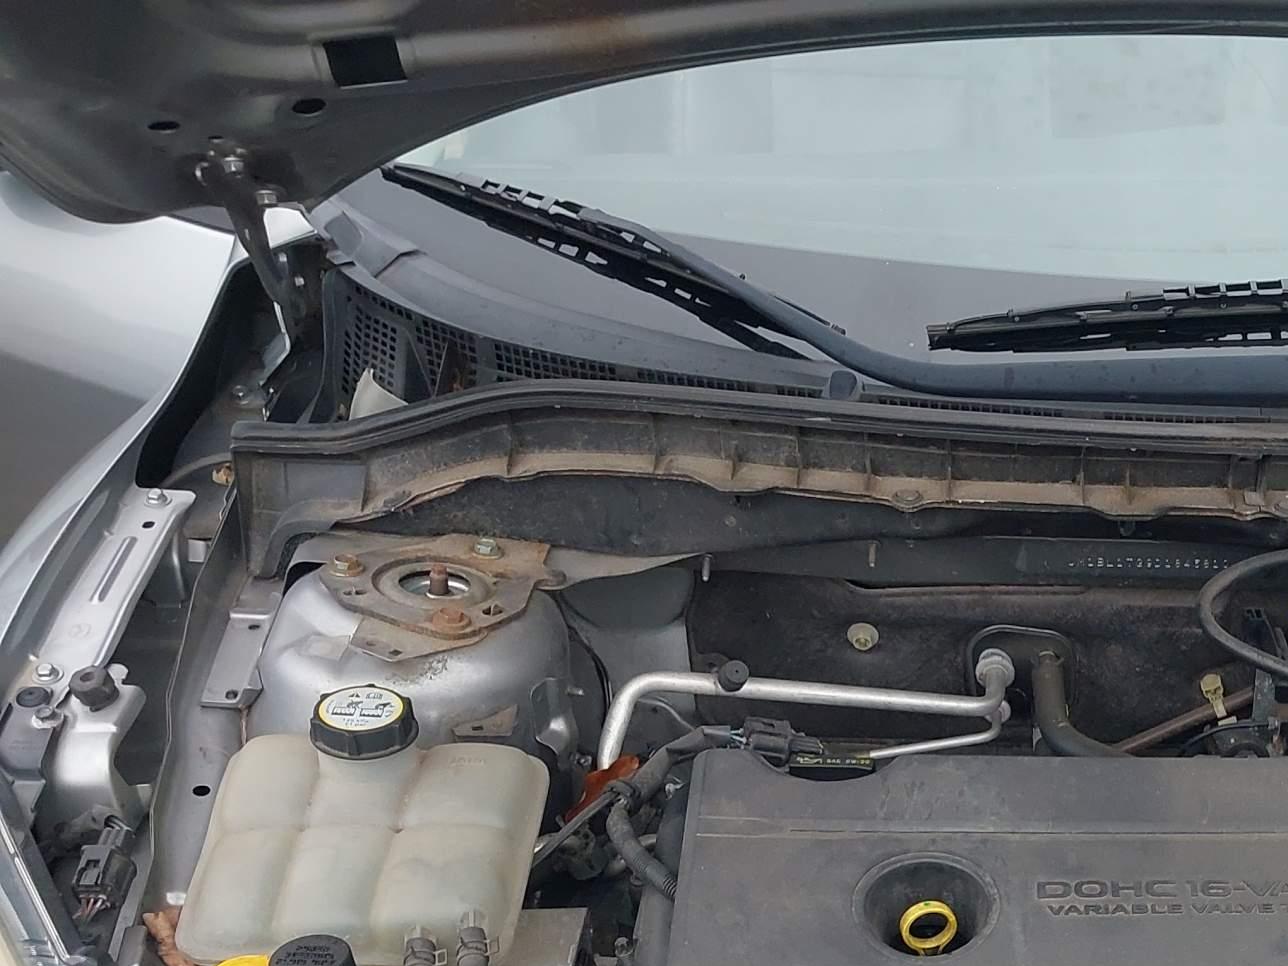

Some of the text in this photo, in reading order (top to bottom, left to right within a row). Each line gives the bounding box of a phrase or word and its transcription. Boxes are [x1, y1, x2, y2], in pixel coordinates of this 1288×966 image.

[1036, 880, 1178, 899] DOHC
[1047, 903, 1184, 917] VARIABLE
[1191, 902, 1275, 915] VALVE
